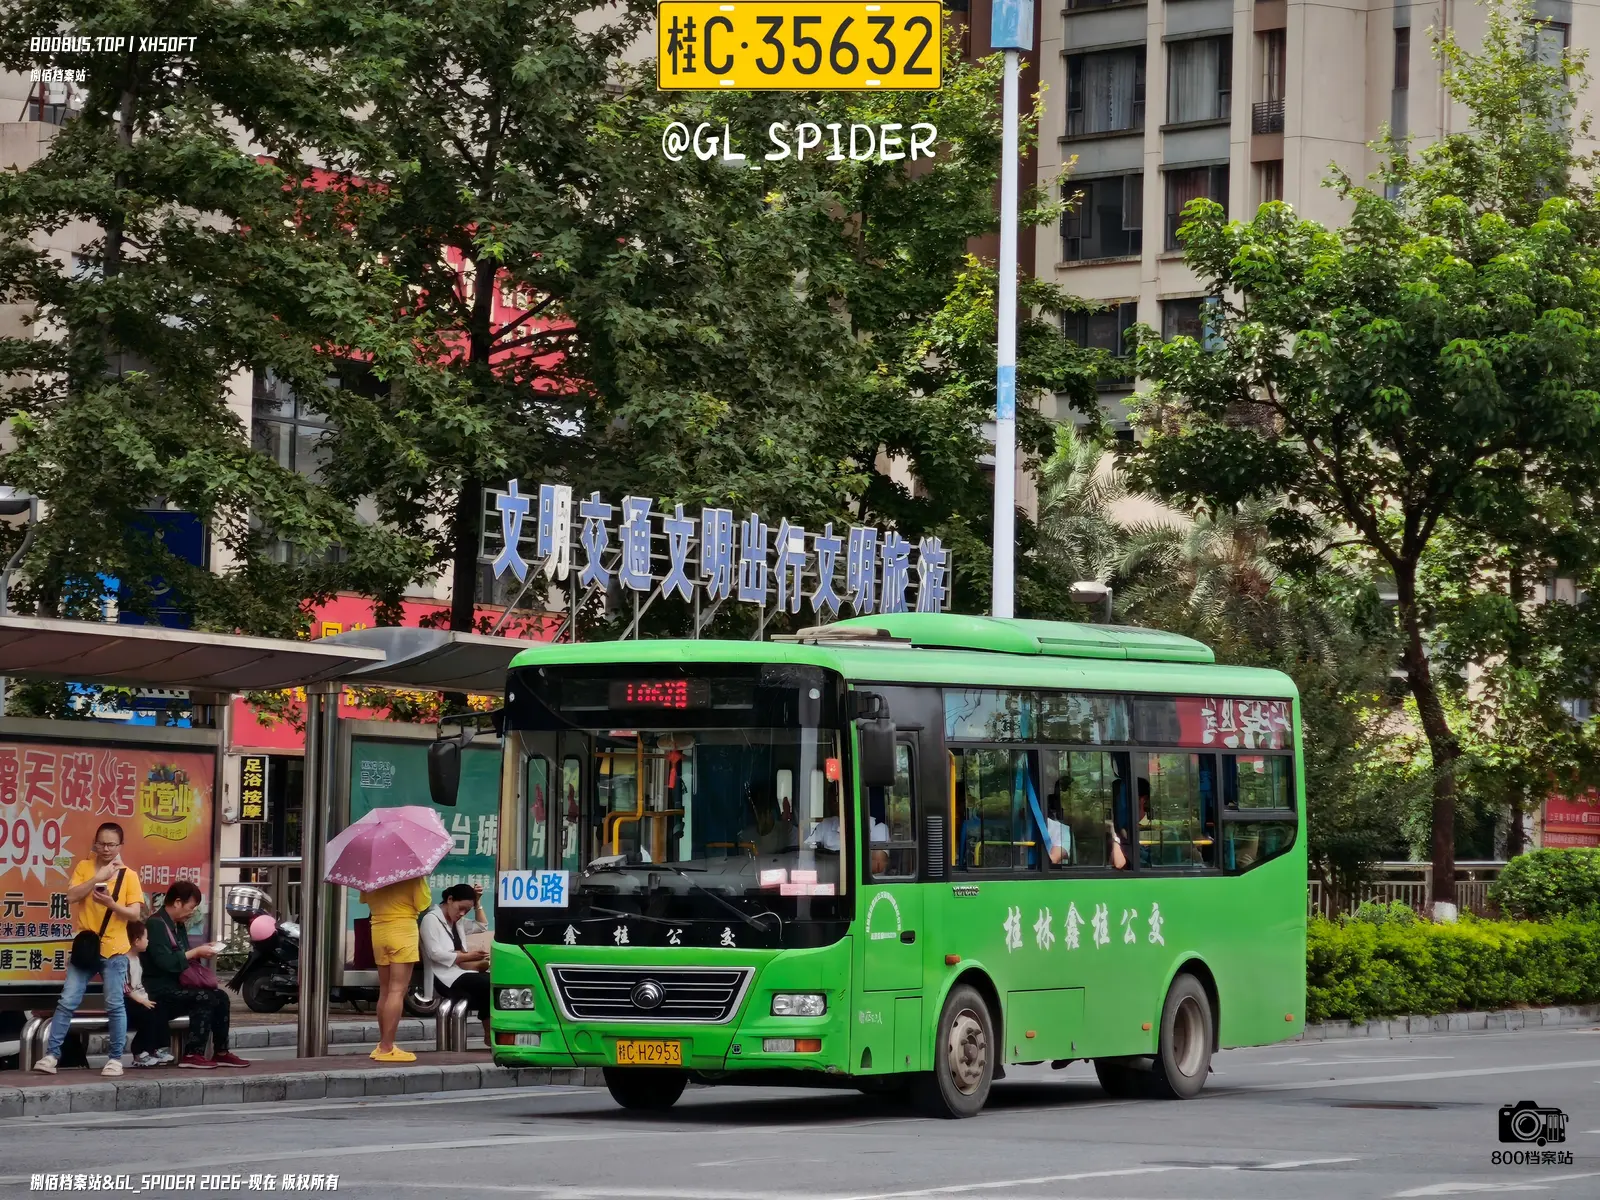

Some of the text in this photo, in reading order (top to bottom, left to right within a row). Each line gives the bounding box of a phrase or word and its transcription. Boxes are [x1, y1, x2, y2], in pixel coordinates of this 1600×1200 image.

[491, 478, 947, 613] 文明交通文明出行文明旅游
[242, 758, 263, 818] 足浴按摩
[438, 812, 499, 856] 台球
[501, 874, 564, 904] 106路
[0, 922, 73, 938] 米酒免费畅饮
[1002, 901, 1165, 955] 桂林鑫桂公交
[0, 948, 75, 971] 唐三楼~星
